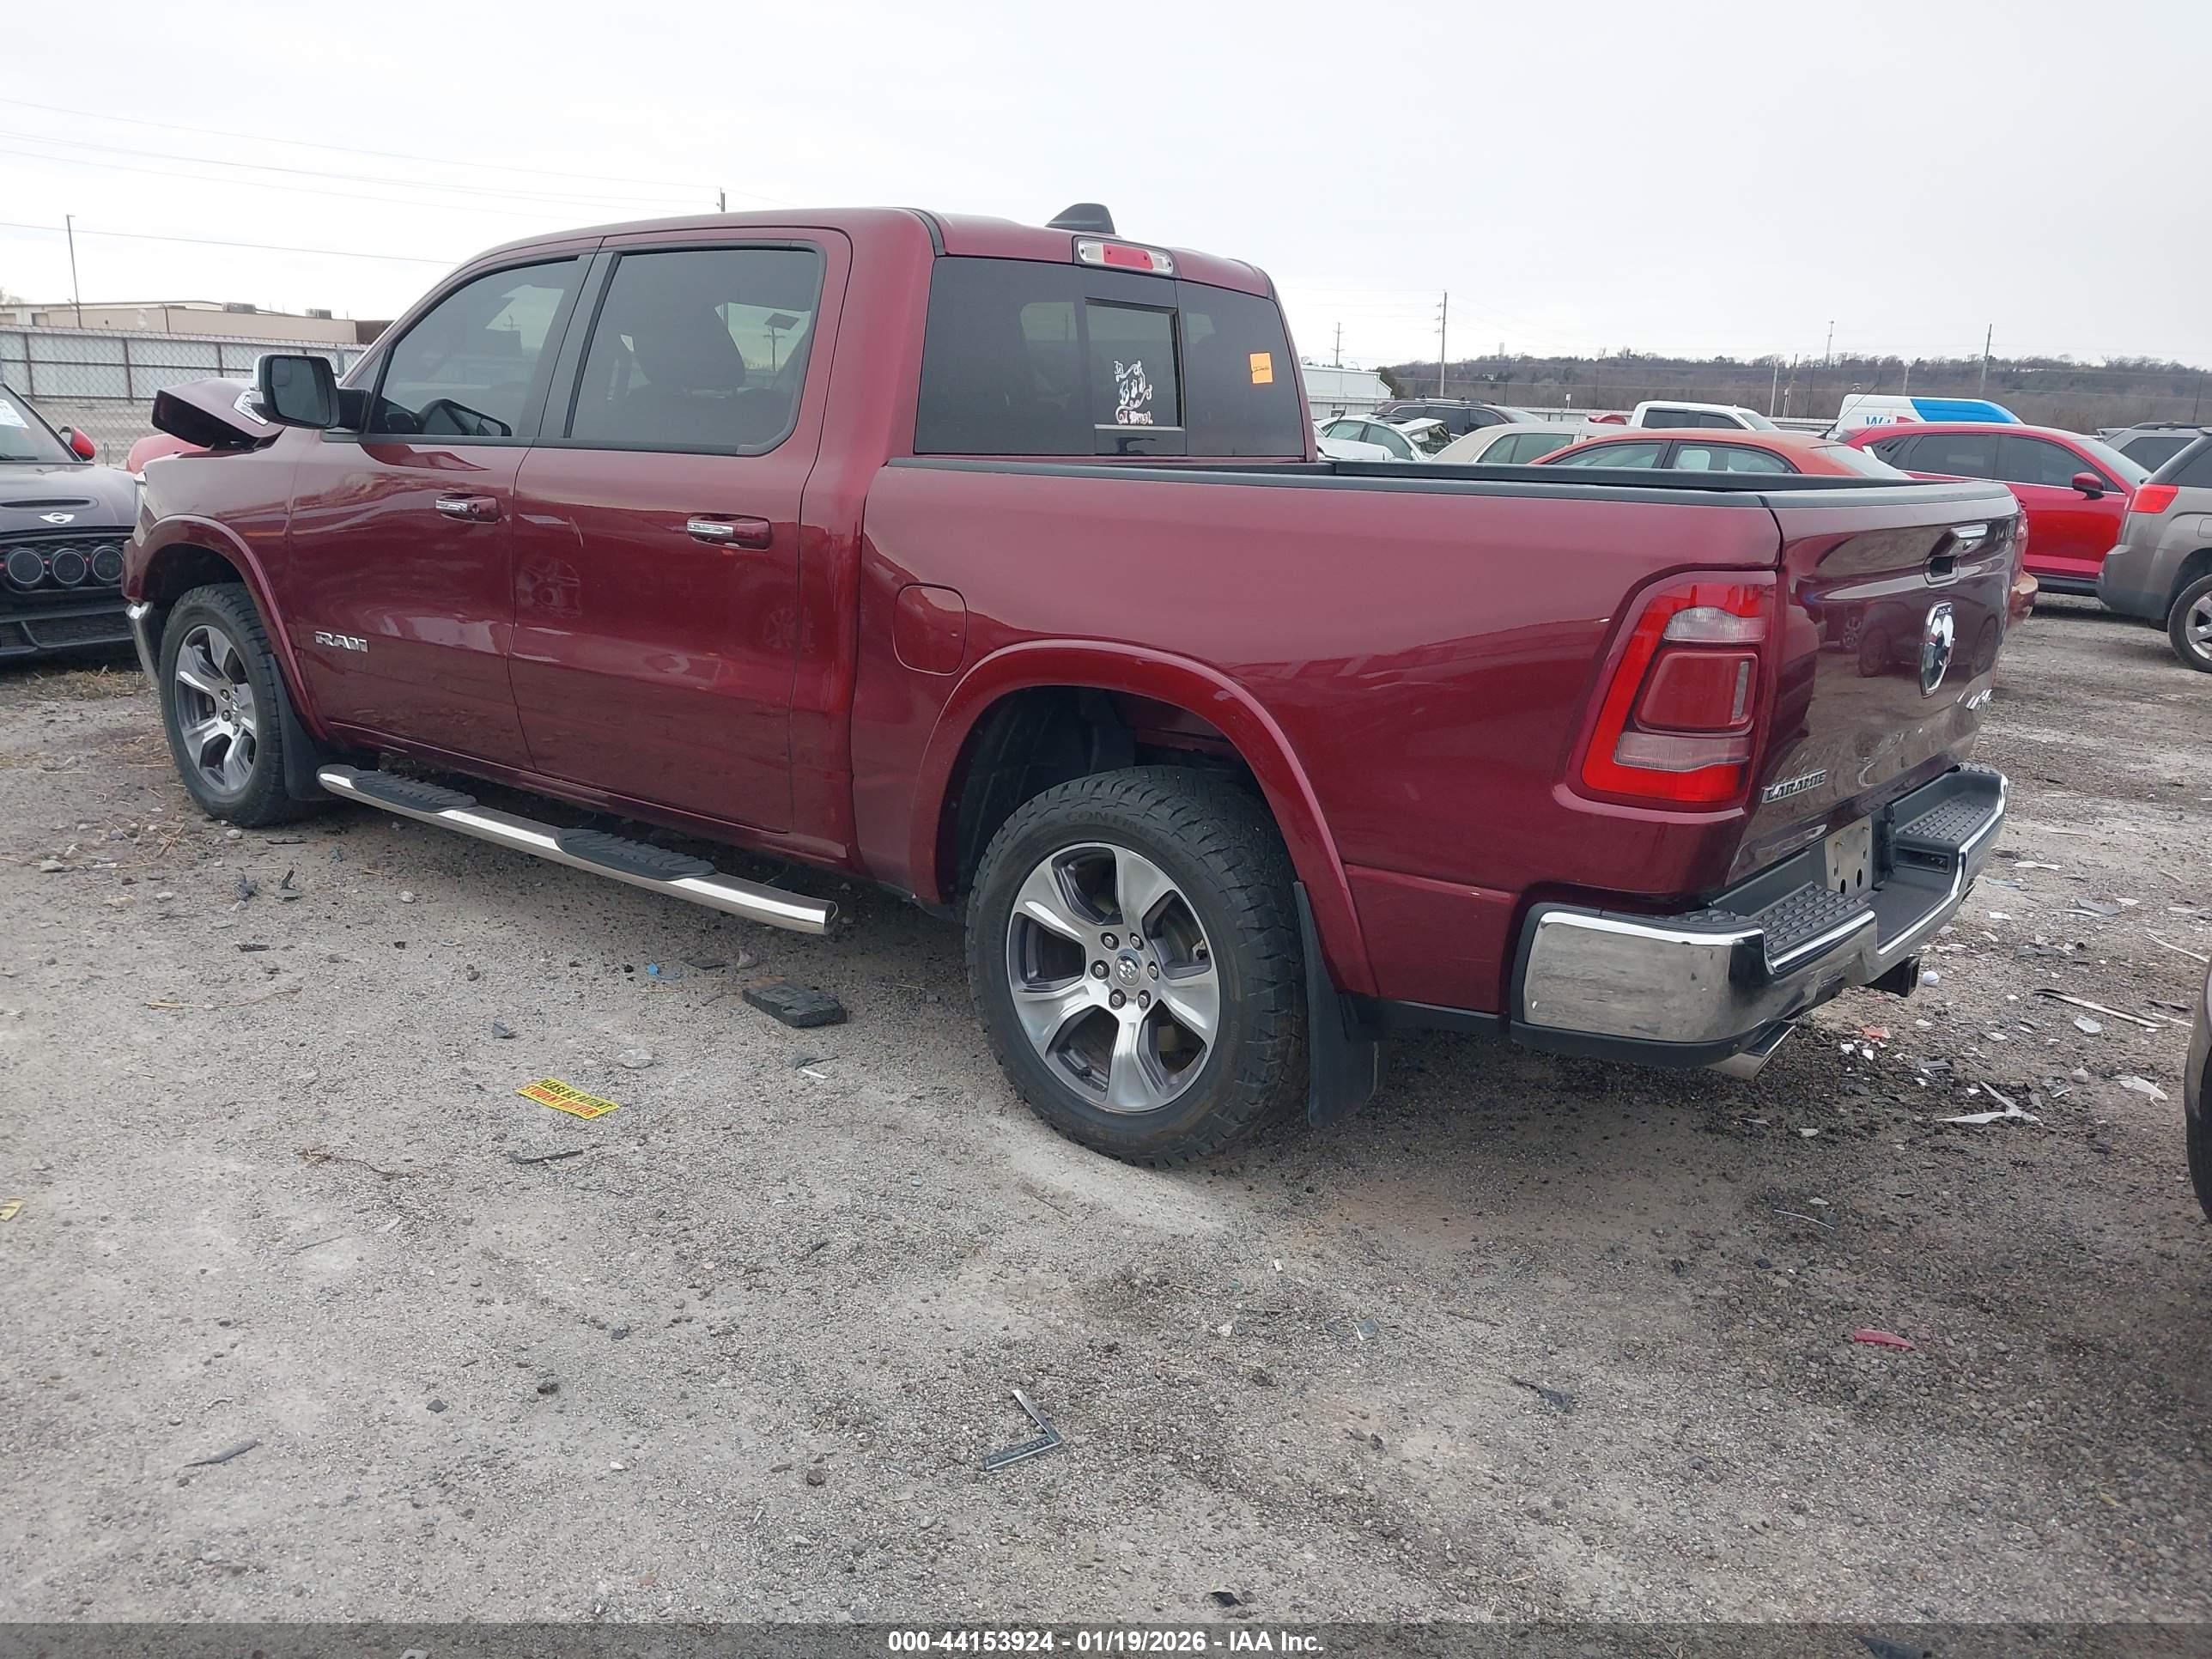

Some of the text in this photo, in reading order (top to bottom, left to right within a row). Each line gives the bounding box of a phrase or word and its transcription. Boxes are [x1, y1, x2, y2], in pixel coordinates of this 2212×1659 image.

[315, 630, 368, 653] RAM
[1761, 769, 1827, 804] LARAMIE
[521, 1085, 599, 1116] STUDENT DRIVER
[536, 1079, 569, 1094] PLEASE
[561, 1090, 580, 1099] BE
